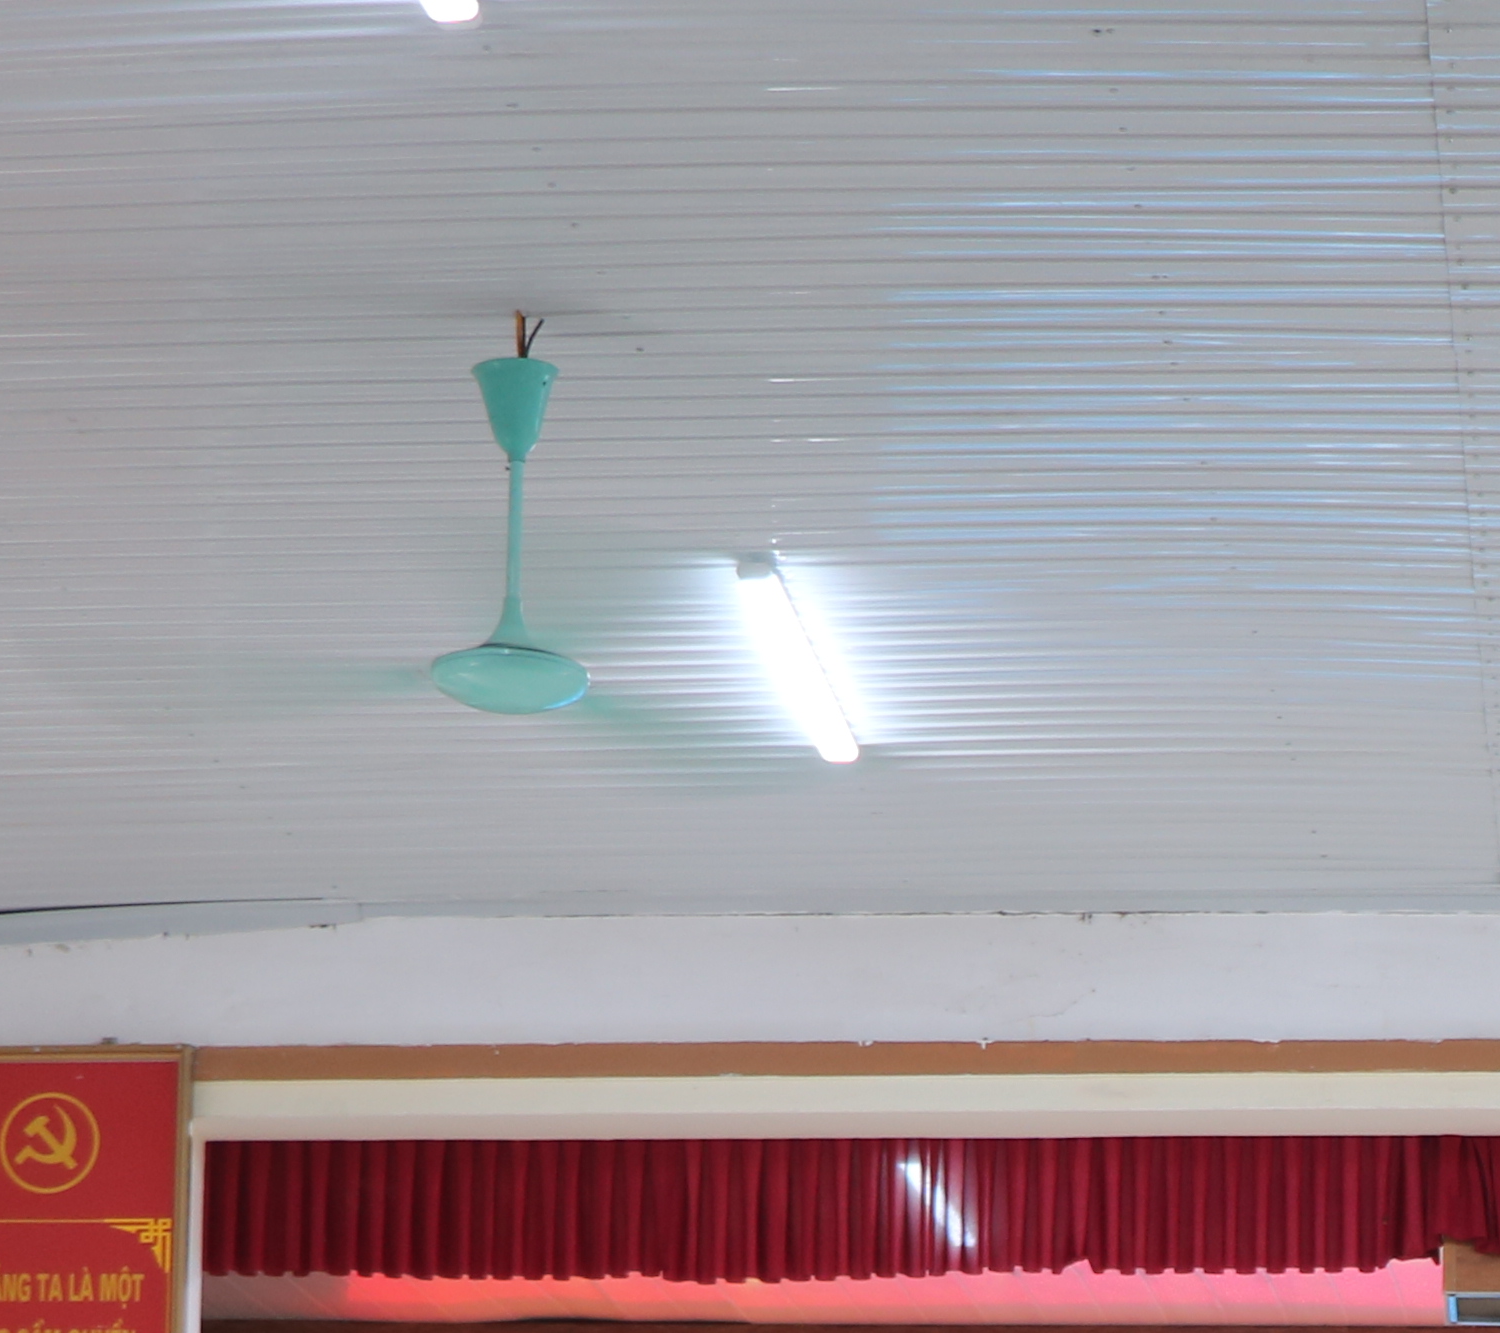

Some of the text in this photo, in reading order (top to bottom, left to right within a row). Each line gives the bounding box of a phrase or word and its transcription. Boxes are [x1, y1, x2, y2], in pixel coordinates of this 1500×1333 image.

[35, 1272, 64, 1302] TA
[67, 1266, 95, 1302] LÀ
[98, 1265, 146, 1310] MỘT
